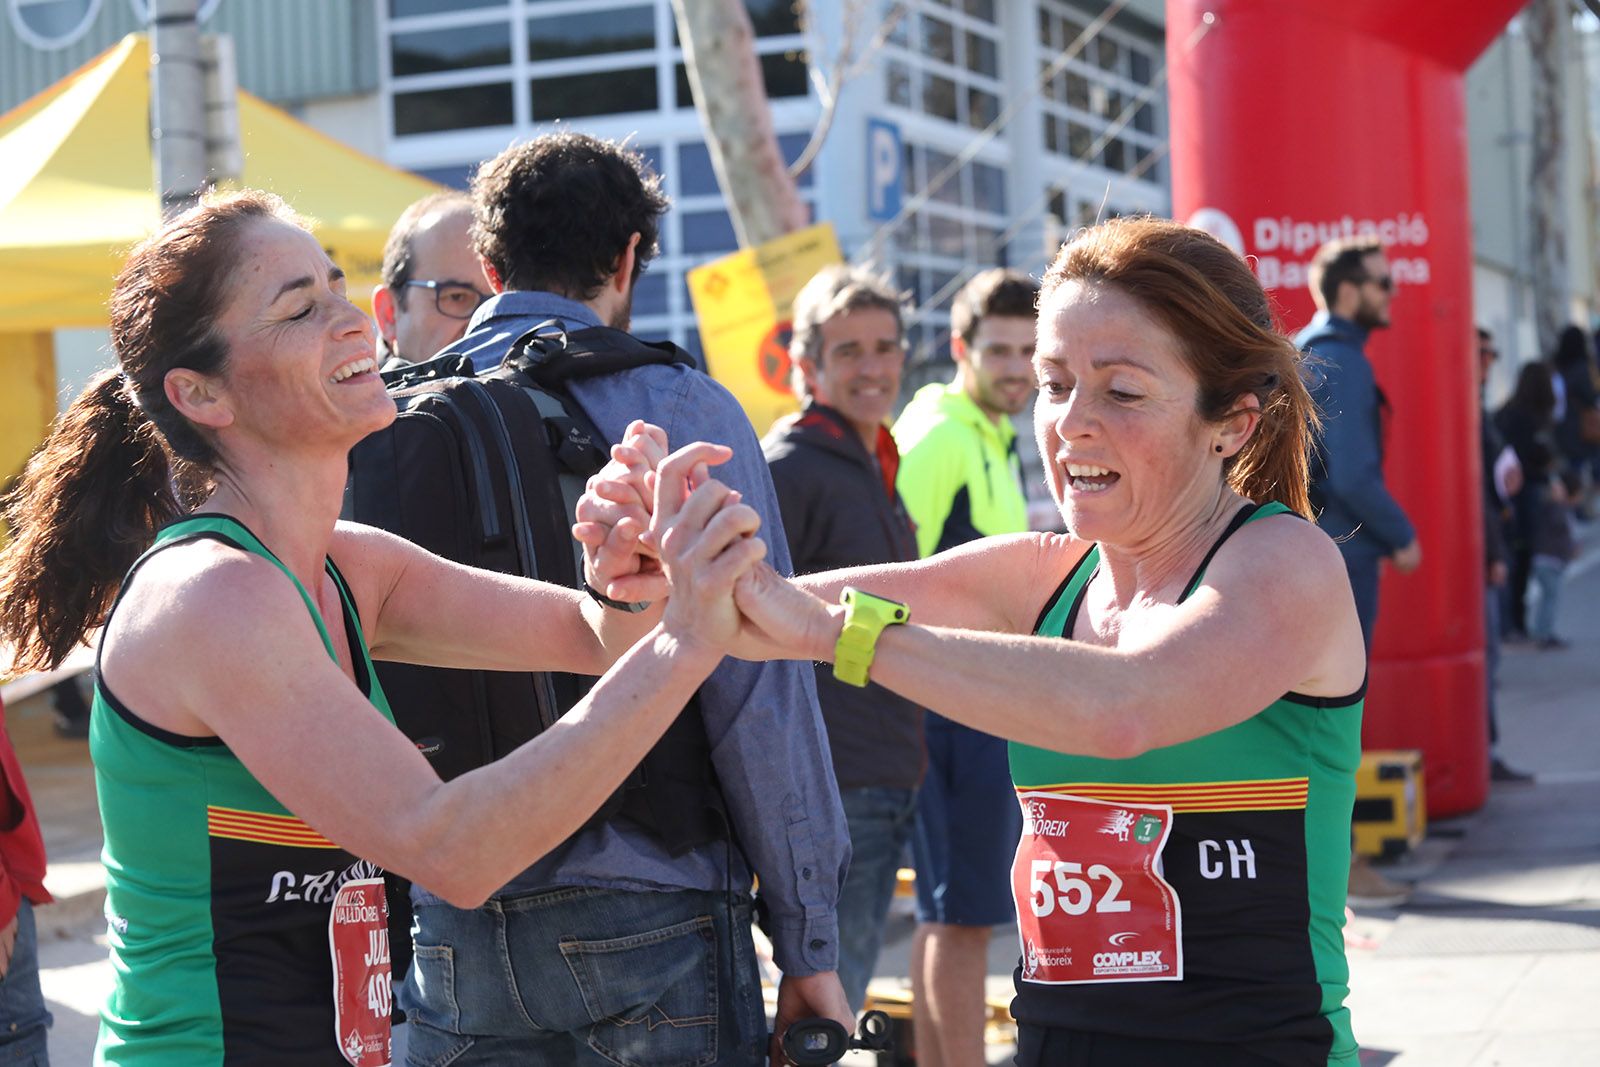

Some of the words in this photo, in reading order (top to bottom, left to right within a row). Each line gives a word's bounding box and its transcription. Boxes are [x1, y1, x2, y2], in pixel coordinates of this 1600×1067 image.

[872, 127, 897, 212] P
[1253, 213, 1429, 254] Diputació
[1144, 823, 1152, 836] 1
[1198, 839, 1257, 879] CH
[1030, 859, 1131, 918] 552
[1092, 950, 1162, 967] COMPLEX
